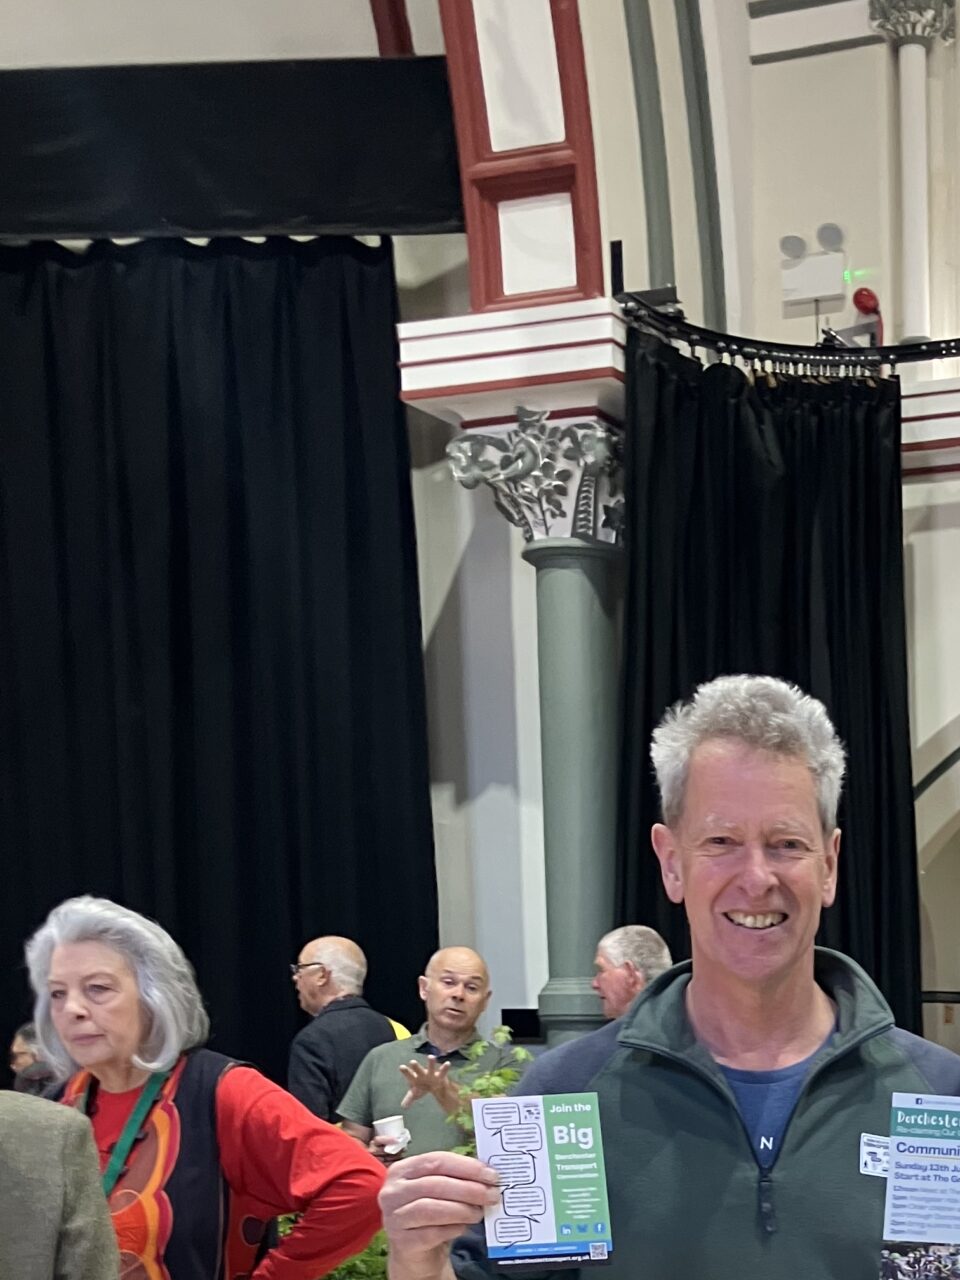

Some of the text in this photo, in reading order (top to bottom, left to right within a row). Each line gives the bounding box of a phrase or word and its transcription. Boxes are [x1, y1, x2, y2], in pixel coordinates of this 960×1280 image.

[550, 1104, 591, 1113] Join the
[553, 1123, 593, 1149] Big
[760, 1136, 773, 1150] N
